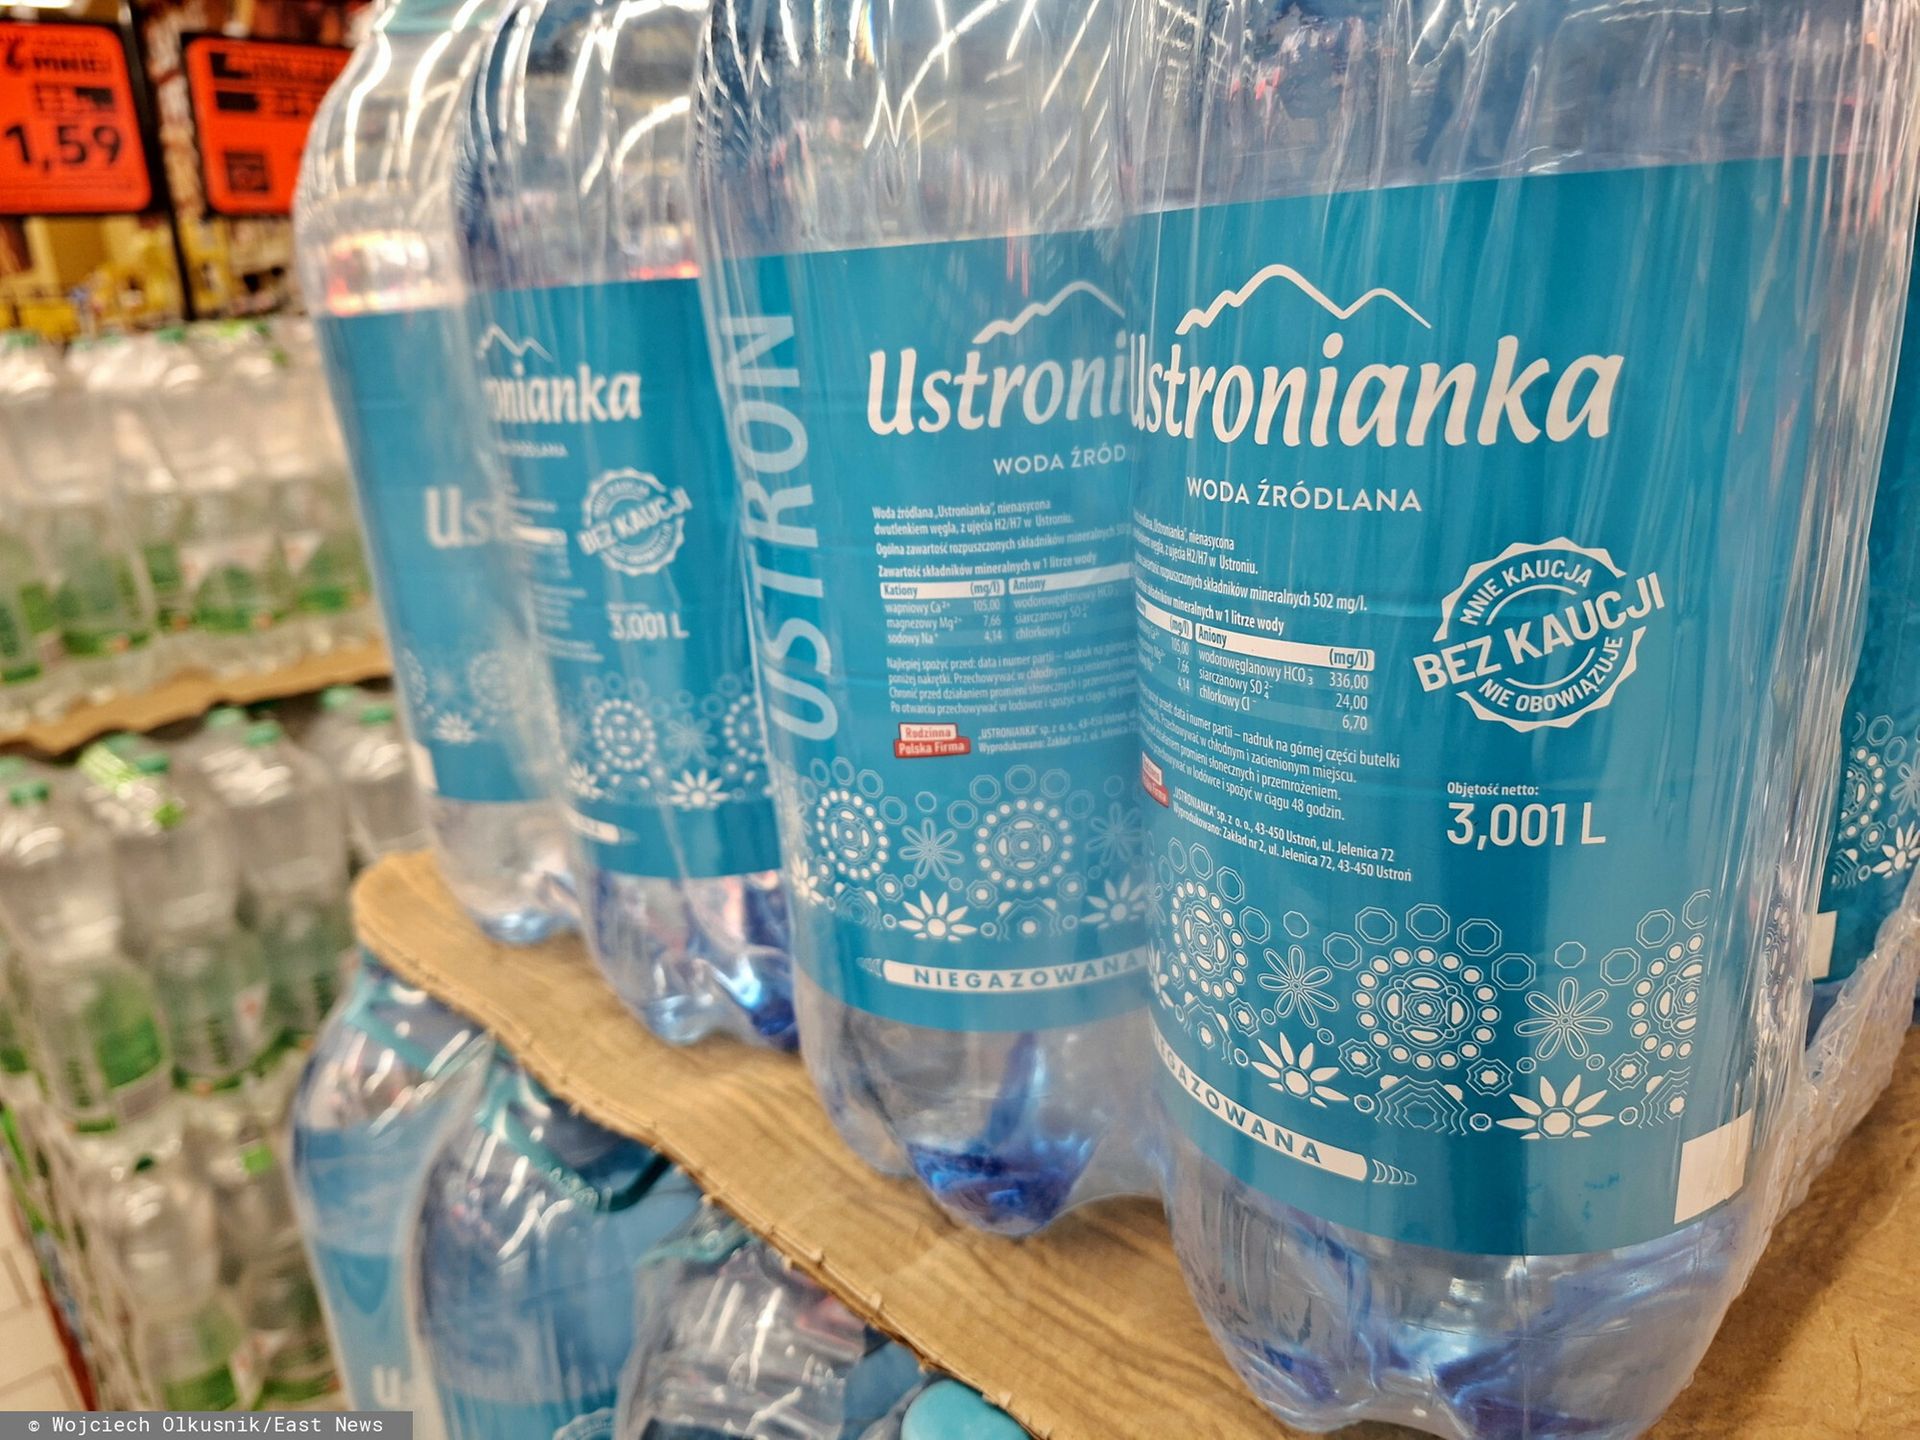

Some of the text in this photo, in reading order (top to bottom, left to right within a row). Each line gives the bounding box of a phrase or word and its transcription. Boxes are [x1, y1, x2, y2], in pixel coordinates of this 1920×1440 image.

[5, 125, 122, 171] 1,59
[1129, 332, 1625, 447] Ustronianka
[993, 453, 1064, 477] WODA
[872, 505, 896, 519] Woda
[1186, 476, 1423, 512] WODA ŹRÓDLANA
[874, 521, 929, 535] dwutlenkiem
[995, 516, 1022, 531] H2/H7
[1023, 519, 1032, 529] w
[1189, 528, 1234, 551] nienasycona
[906, 541, 948, 556] zawartość
[949, 537, 1016, 557] rozpuszczonych
[1187, 548, 1208, 567] H2/H7
[1209, 555, 1216, 568] w
[1219, 554, 1258, 575] Ustroniu.
[878, 564, 921, 578] Zawartość
[922, 563, 973, 578] składników
[974, 558, 1031, 575] mineralnych
[1032, 561, 1041, 570] w
[1013, 578, 1046, 592] Aniony
[883, 580, 1001, 599] Kationy (mg/l)
[1203, 576, 1250, 600] składników
[1250, 586, 1310, 609] mineralnych
[1313, 592, 1334, 609] 502
[1336, 594, 1368, 614] mg/l.
[1459, 559, 1592, 626] MNIE KAUCJA
[1173, 596, 1215, 620] mineralnych
[1215, 610, 1223, 622] w
[1231, 610, 1255, 628] litrze
[1257, 616, 1284, 636] wody
[1412, 571, 1666, 692] BEZ KAUCJI
[1198, 625, 1369, 669] Aniony (mg/l)
[1198, 648, 1282, 682] wodorowęglanowy
[1329, 670, 1368, 691] 336,00
[1199, 667, 1368, 711] siarczanowy 24,00
[1477, 636, 1624, 713] NIE OBOWIĄZUJE
[1199, 684, 1368, 731] chlorkowy 6,70
[898, 741, 965, 755] Polska Firma
[904, 727, 951, 739] Rodzinna
[1190, 713, 1211, 731] numer
[1212, 722, 1233, 739] partii
[1243, 731, 1274, 750] nadruk
[1276, 740, 1288, 752] na
[1290, 741, 1323, 762] górnej
[1325, 747, 1356, 765] części
[1360, 750, 1400, 769] butelki
[1207, 738, 1245, 761] chłodnym
[1251, 752, 1310, 776] zacienionym
[1312, 764, 1357, 783] miejscu.
[1208, 754, 1255, 782] słonecznych
[1262, 772, 1341, 801] przemrożeniem.
[1226, 782, 1253, 801] spożyć
[1253, 790, 1262, 802] w
[1264, 790, 1289, 811] ciągu
[1291, 797, 1304, 813] 48
[1306, 803, 1345, 821] godzin.
[1447, 781, 1540, 798] Objętość netto:
[1216, 811, 1227, 824] sp.
[1235, 817, 1242, 829] o.
[1255, 822, 1285, 841] 43-450
[1286, 830, 1320, 851] Ustroń,
[1322, 838, 1335, 853] ul.
[1336, 840, 1378, 860] Jelenica
[1380, 847, 1394, 863] 72
[1446, 801, 1607, 851] 3,001 L
[1222, 825, 1247, 847] Zakład
[1248, 839, 1257, 850] nr
[1258, 839, 1267, 854] 2,
[1268, 843, 1280, 856] ul.
[1280, 845, 1318, 867] Jelenica
[1320, 855, 1335, 871] 72,
[1337, 859, 1374, 877] 43-450
[1376, 864, 1412, 882] Ustroń
[913, 952, 1139, 990] NIEGAZOWANA
